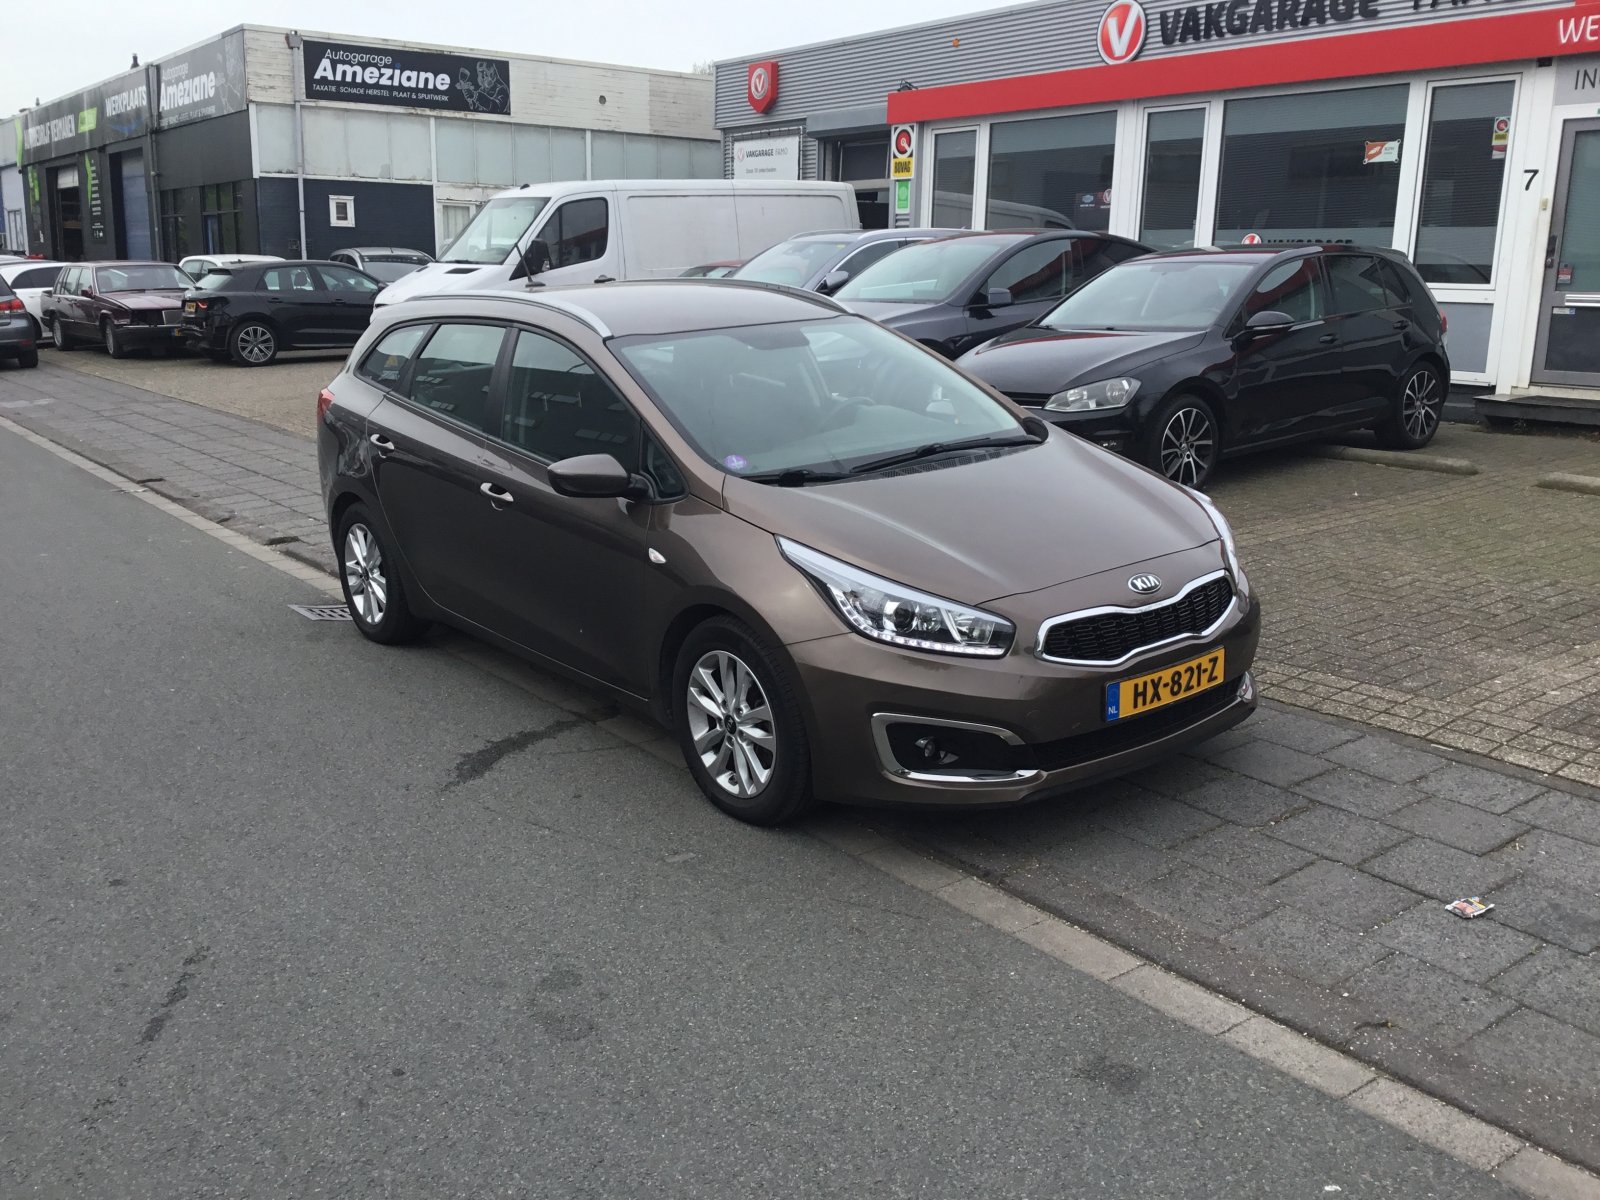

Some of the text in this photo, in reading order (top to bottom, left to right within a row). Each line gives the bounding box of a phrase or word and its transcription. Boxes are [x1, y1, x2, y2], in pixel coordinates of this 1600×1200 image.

[1160, 0, 1379, 45] VAKGARAGE
[324, 49, 393, 66] Autogarage
[313, 58, 451, 91] Ameziane
[1574, 68, 1600, 90] IN
[105, 85, 147, 117] WERKPLAATS
[159, 71, 216, 112] Ameziane
[312, 84, 337, 92] TAXATIE
[340, 86, 365, 95] SCHADE
[366, 88, 390, 97] HERSTEL
[417, 93, 449, 101] SPUITWERK
[746, 149, 774, 158] VAKGARAGE
[894, 161, 911, 173] BOVAG
[1523, 169, 1540, 191] 7
[1133, 575, 1160, 591] KIA
[1133, 655, 1219, 709] HX-821-Z
[1108, 706, 1118, 715] NL
